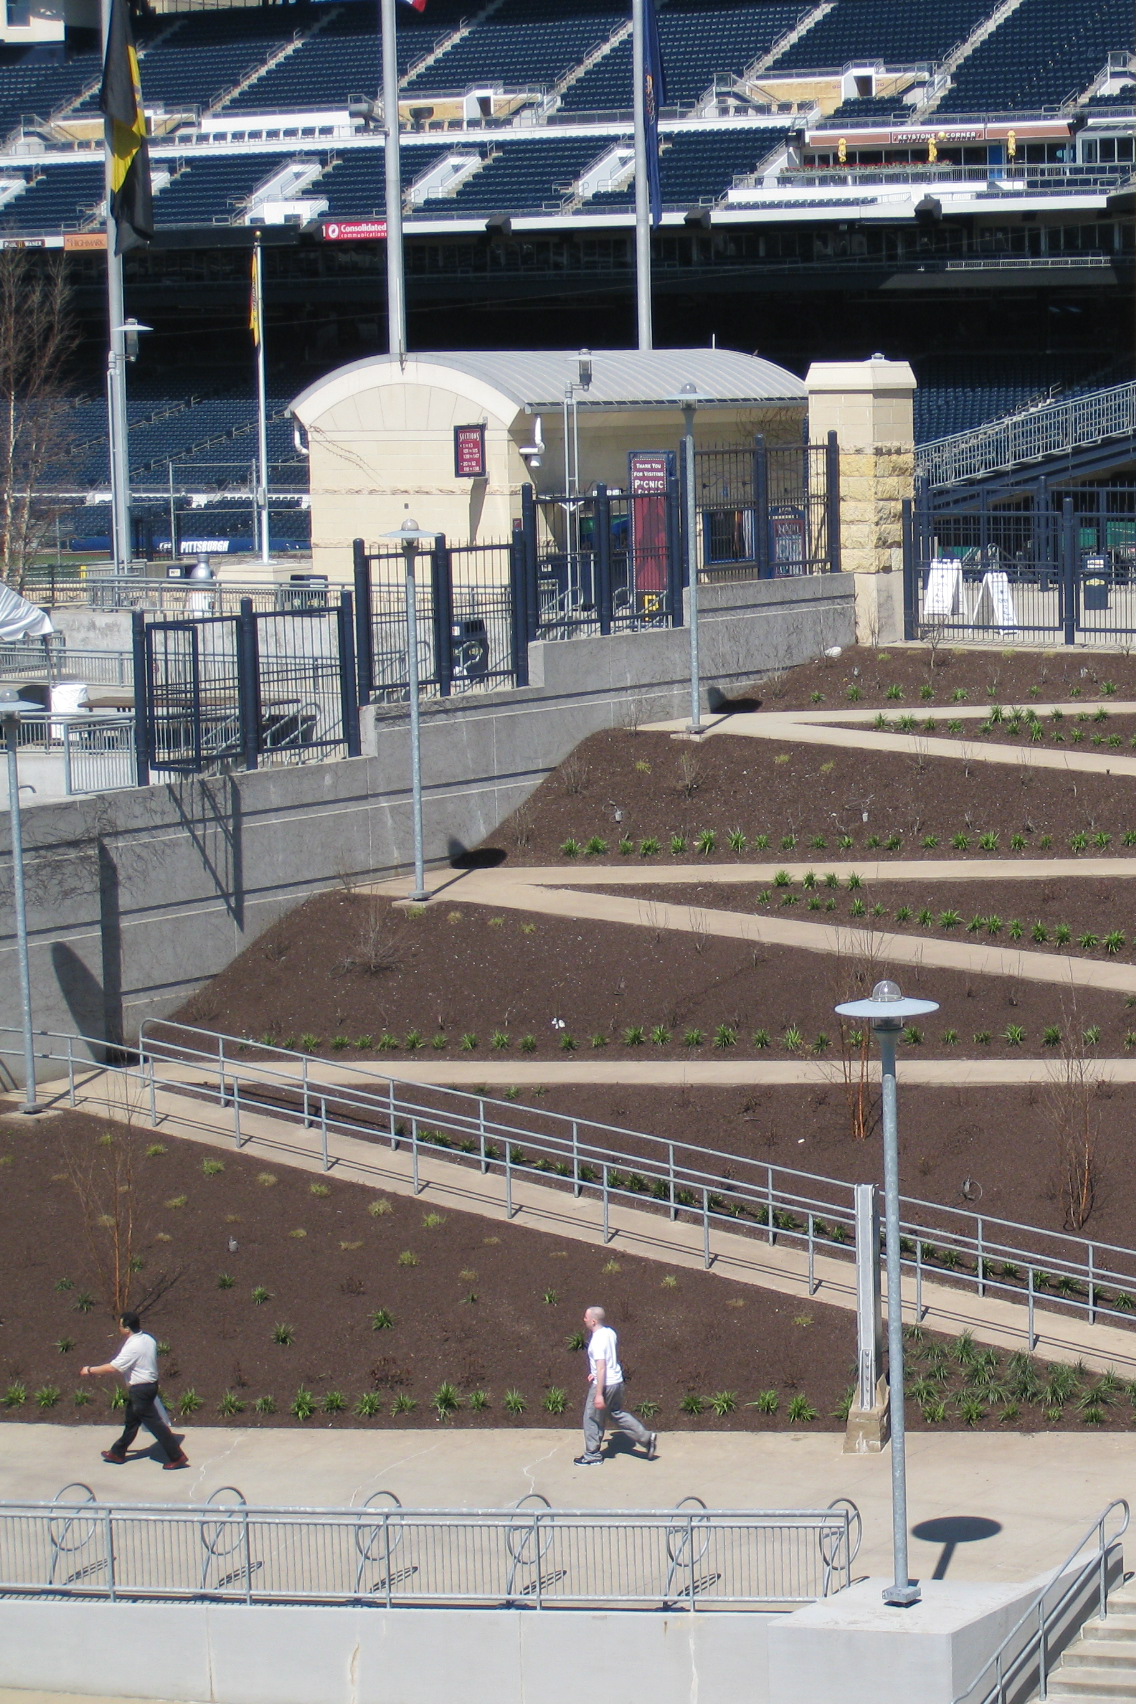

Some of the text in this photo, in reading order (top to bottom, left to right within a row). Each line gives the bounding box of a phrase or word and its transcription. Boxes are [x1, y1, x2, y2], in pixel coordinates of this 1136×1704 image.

[340, 223, 387, 232] Consolidated
[460, 432, 480, 442] SECTIONS
[634, 479, 664, 489] PICNIC
[180, 540, 230, 553] PITTSBURGH
